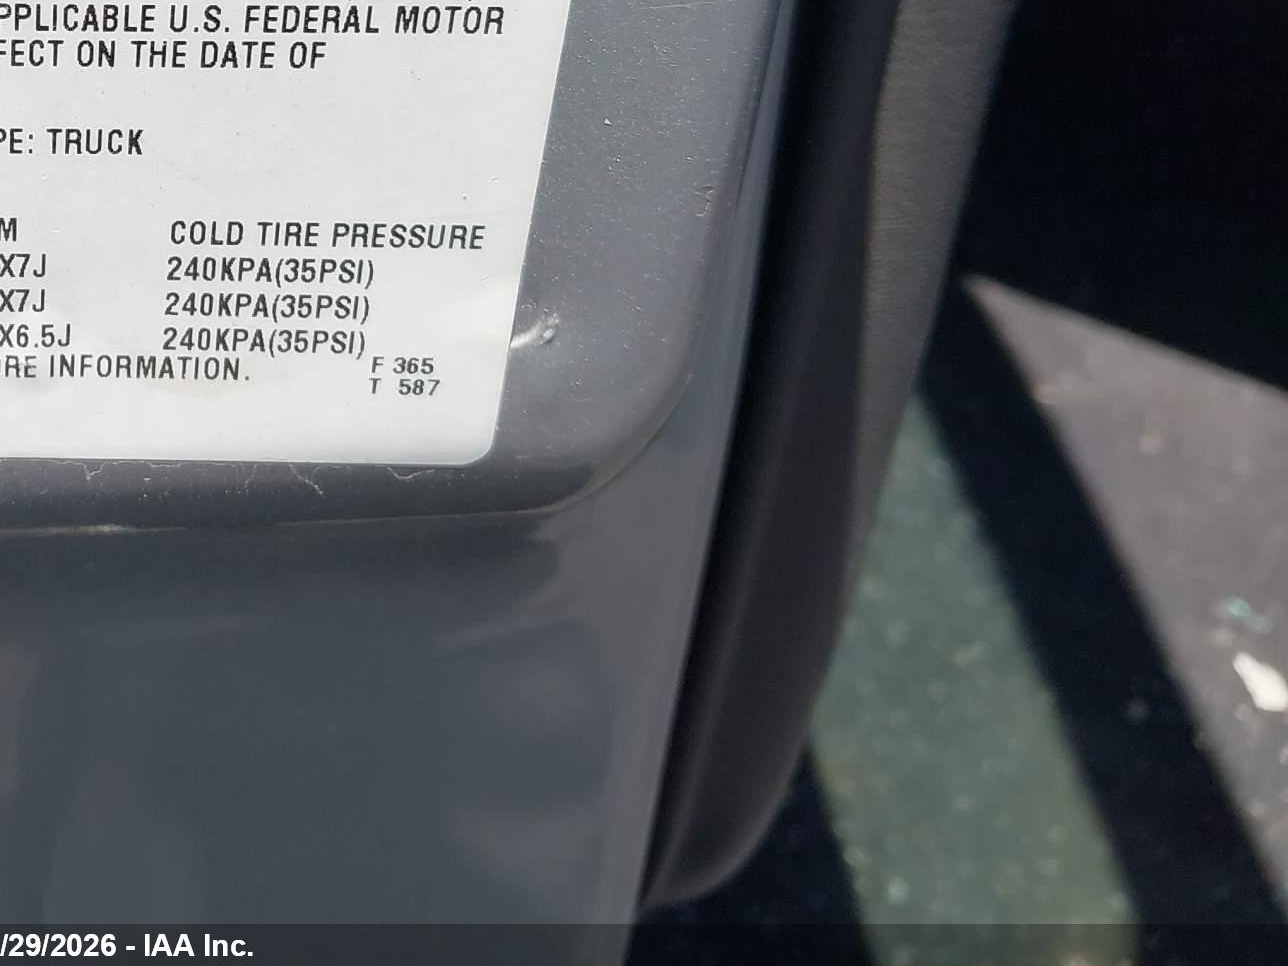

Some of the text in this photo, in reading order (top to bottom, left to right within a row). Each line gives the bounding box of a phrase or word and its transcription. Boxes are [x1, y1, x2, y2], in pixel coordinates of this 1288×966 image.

[169, 5, 229, 32] U.S.
[245, 6, 379, 33] FEDERAL
[394, 6, 504, 34] MOTOR
[77, 40, 113, 67] ON
[129, 41, 186, 67] THE
[201, 42, 275, 68] DATE
[289, 42, 325, 68] OF
[48, 128, 144, 155] TRUCK
[170, 221, 486, 250] COLD TIRE PRESSURE
[167, 257, 374, 288] 240KPA(35PSI)
[164, 292, 370, 324] 240KPA(35PSI)
[162, 328, 365, 359] 240KPA(35PSI)
[50, 356, 250, 381] INFORMATION.
[372, 358, 434, 374] F 365
[370, 378, 440, 396] T 587
